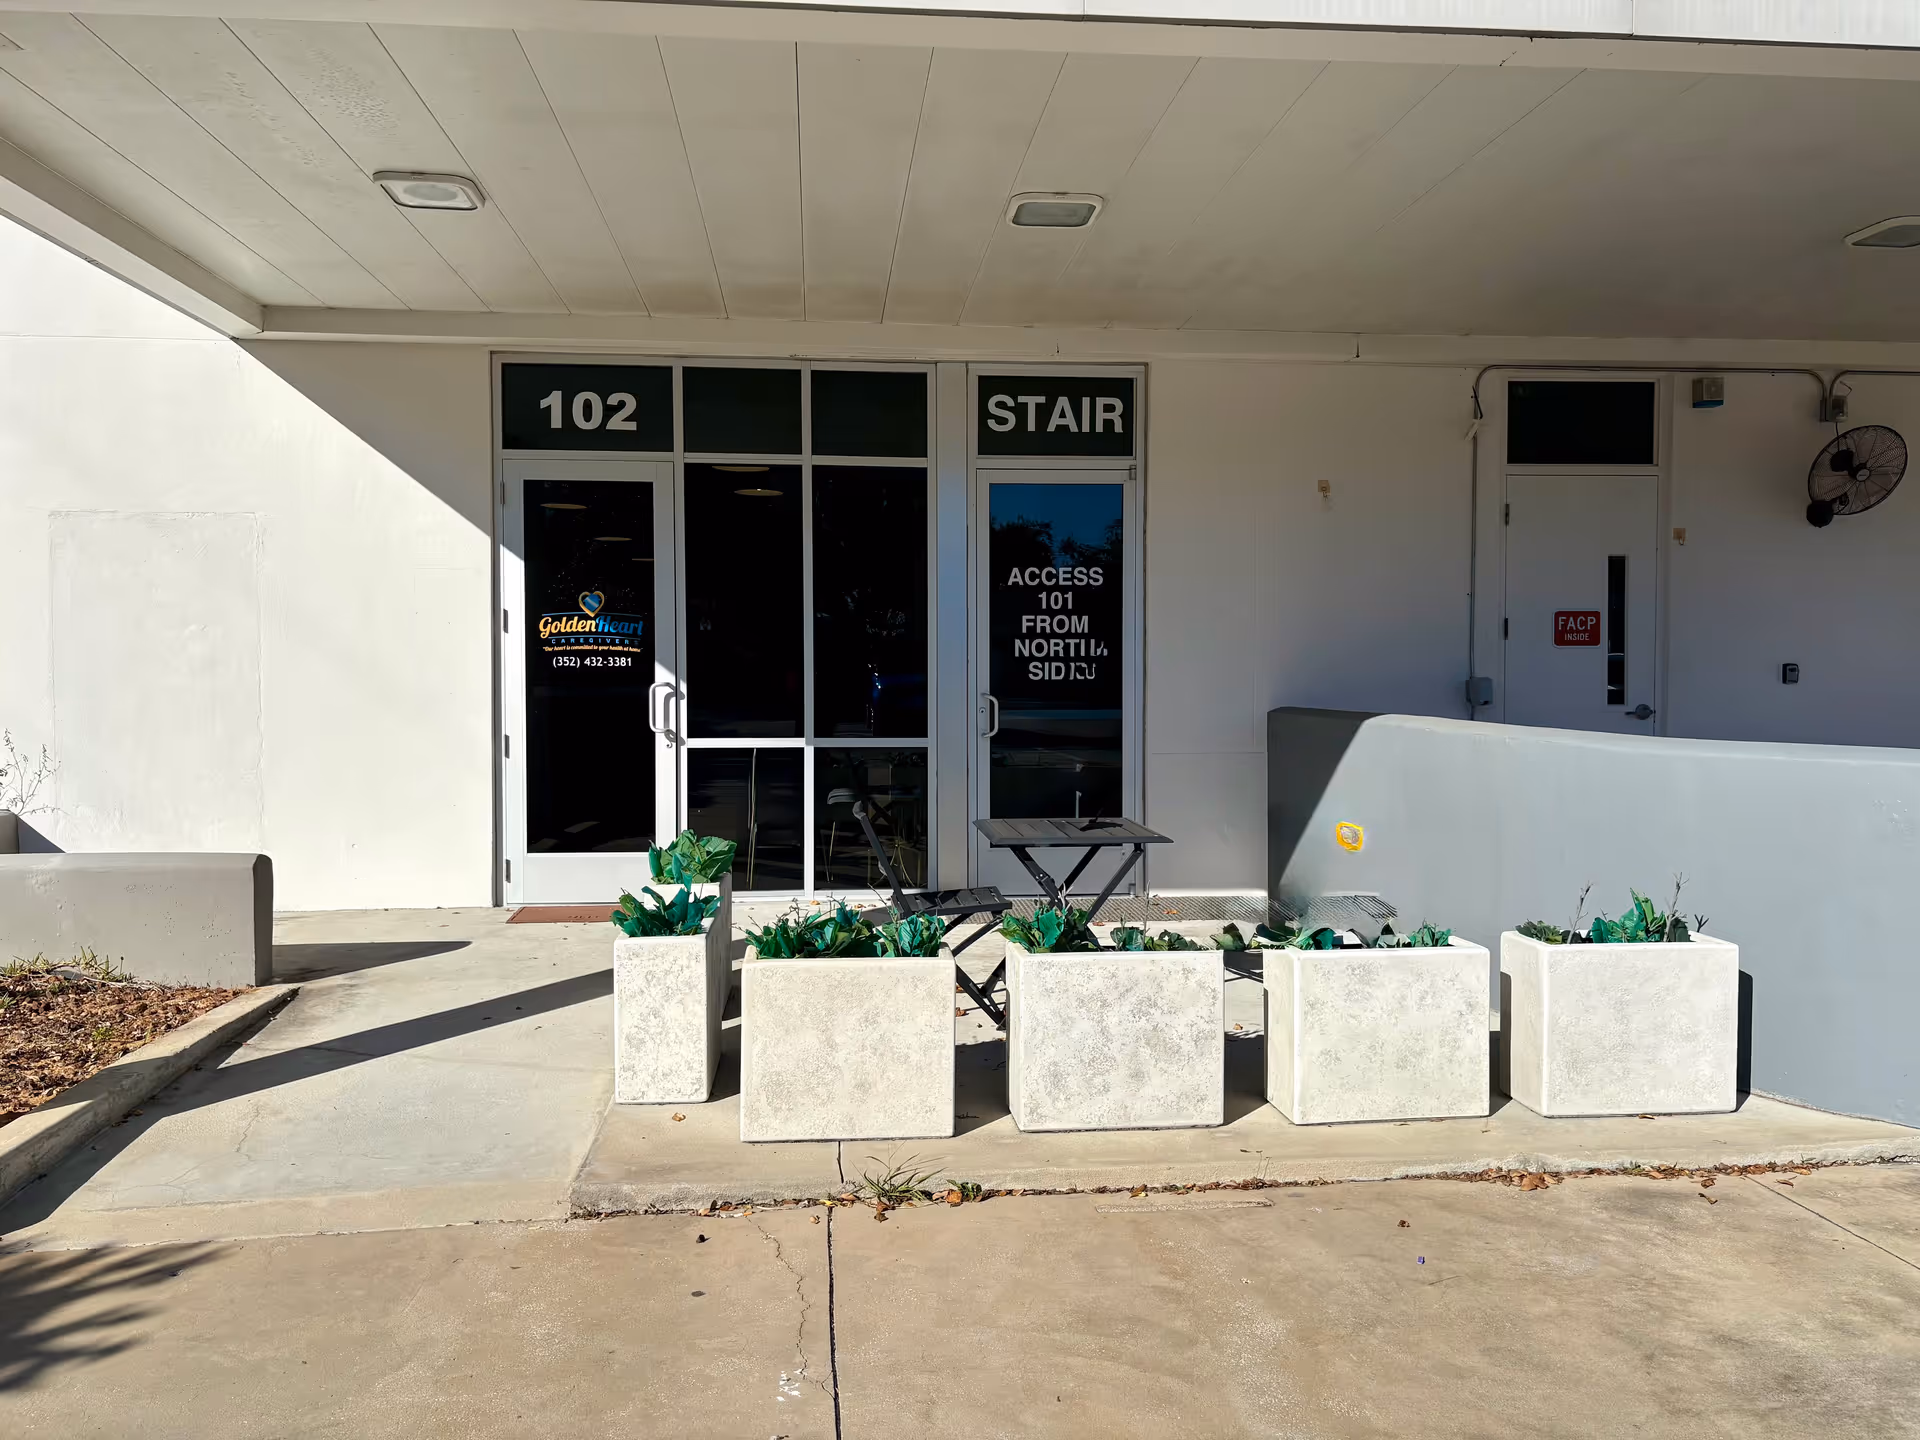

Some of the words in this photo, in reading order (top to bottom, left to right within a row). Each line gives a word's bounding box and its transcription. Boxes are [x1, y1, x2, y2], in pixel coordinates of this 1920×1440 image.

[540, 390, 637, 431] 102
[987, 394, 1124, 433] STAIR
[1007, 566, 1104, 586] ACCESS
[1038, 591, 1073, 610] 101
[1021, 615, 1089, 634] FROM
[1558, 616, 1596, 630] FACP
[1564, 633, 1590, 641] INSIDE
[552, 656, 581, 668] (352)
[583, 656, 632, 667] 432-3381
